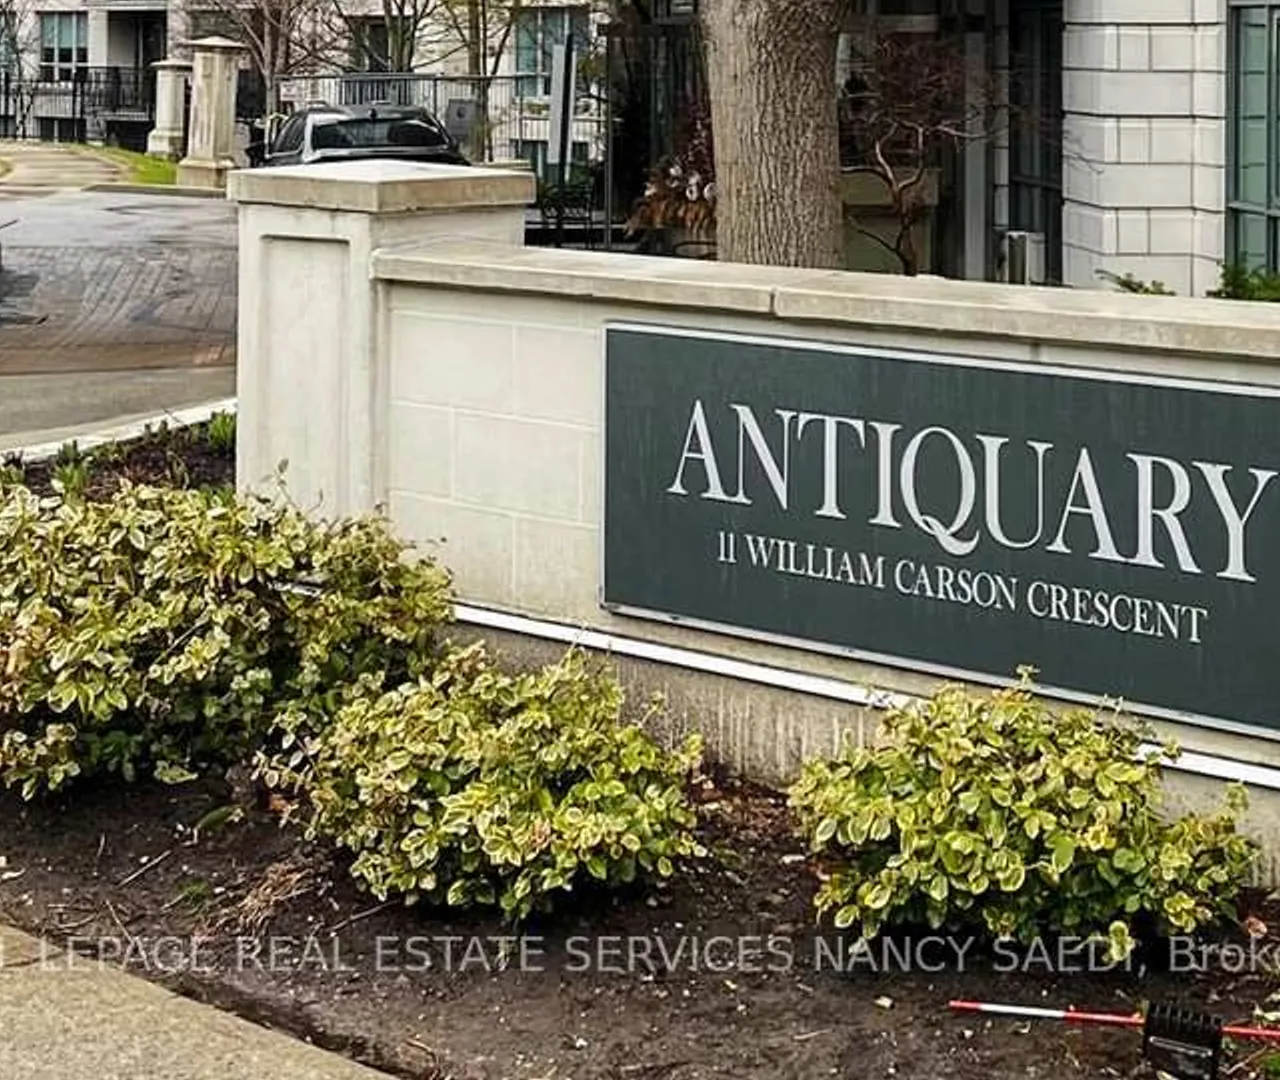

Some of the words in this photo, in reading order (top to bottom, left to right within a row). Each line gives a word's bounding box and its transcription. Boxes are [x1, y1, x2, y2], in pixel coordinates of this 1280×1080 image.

[667, 400, 1279, 582] ANTIQUARY
[717, 531, 738, 563] 11
[745, 534, 886, 589] WILLIAM
[894, 559, 1018, 610] CARSON
[1026, 582, 1209, 644] CRESCENT
